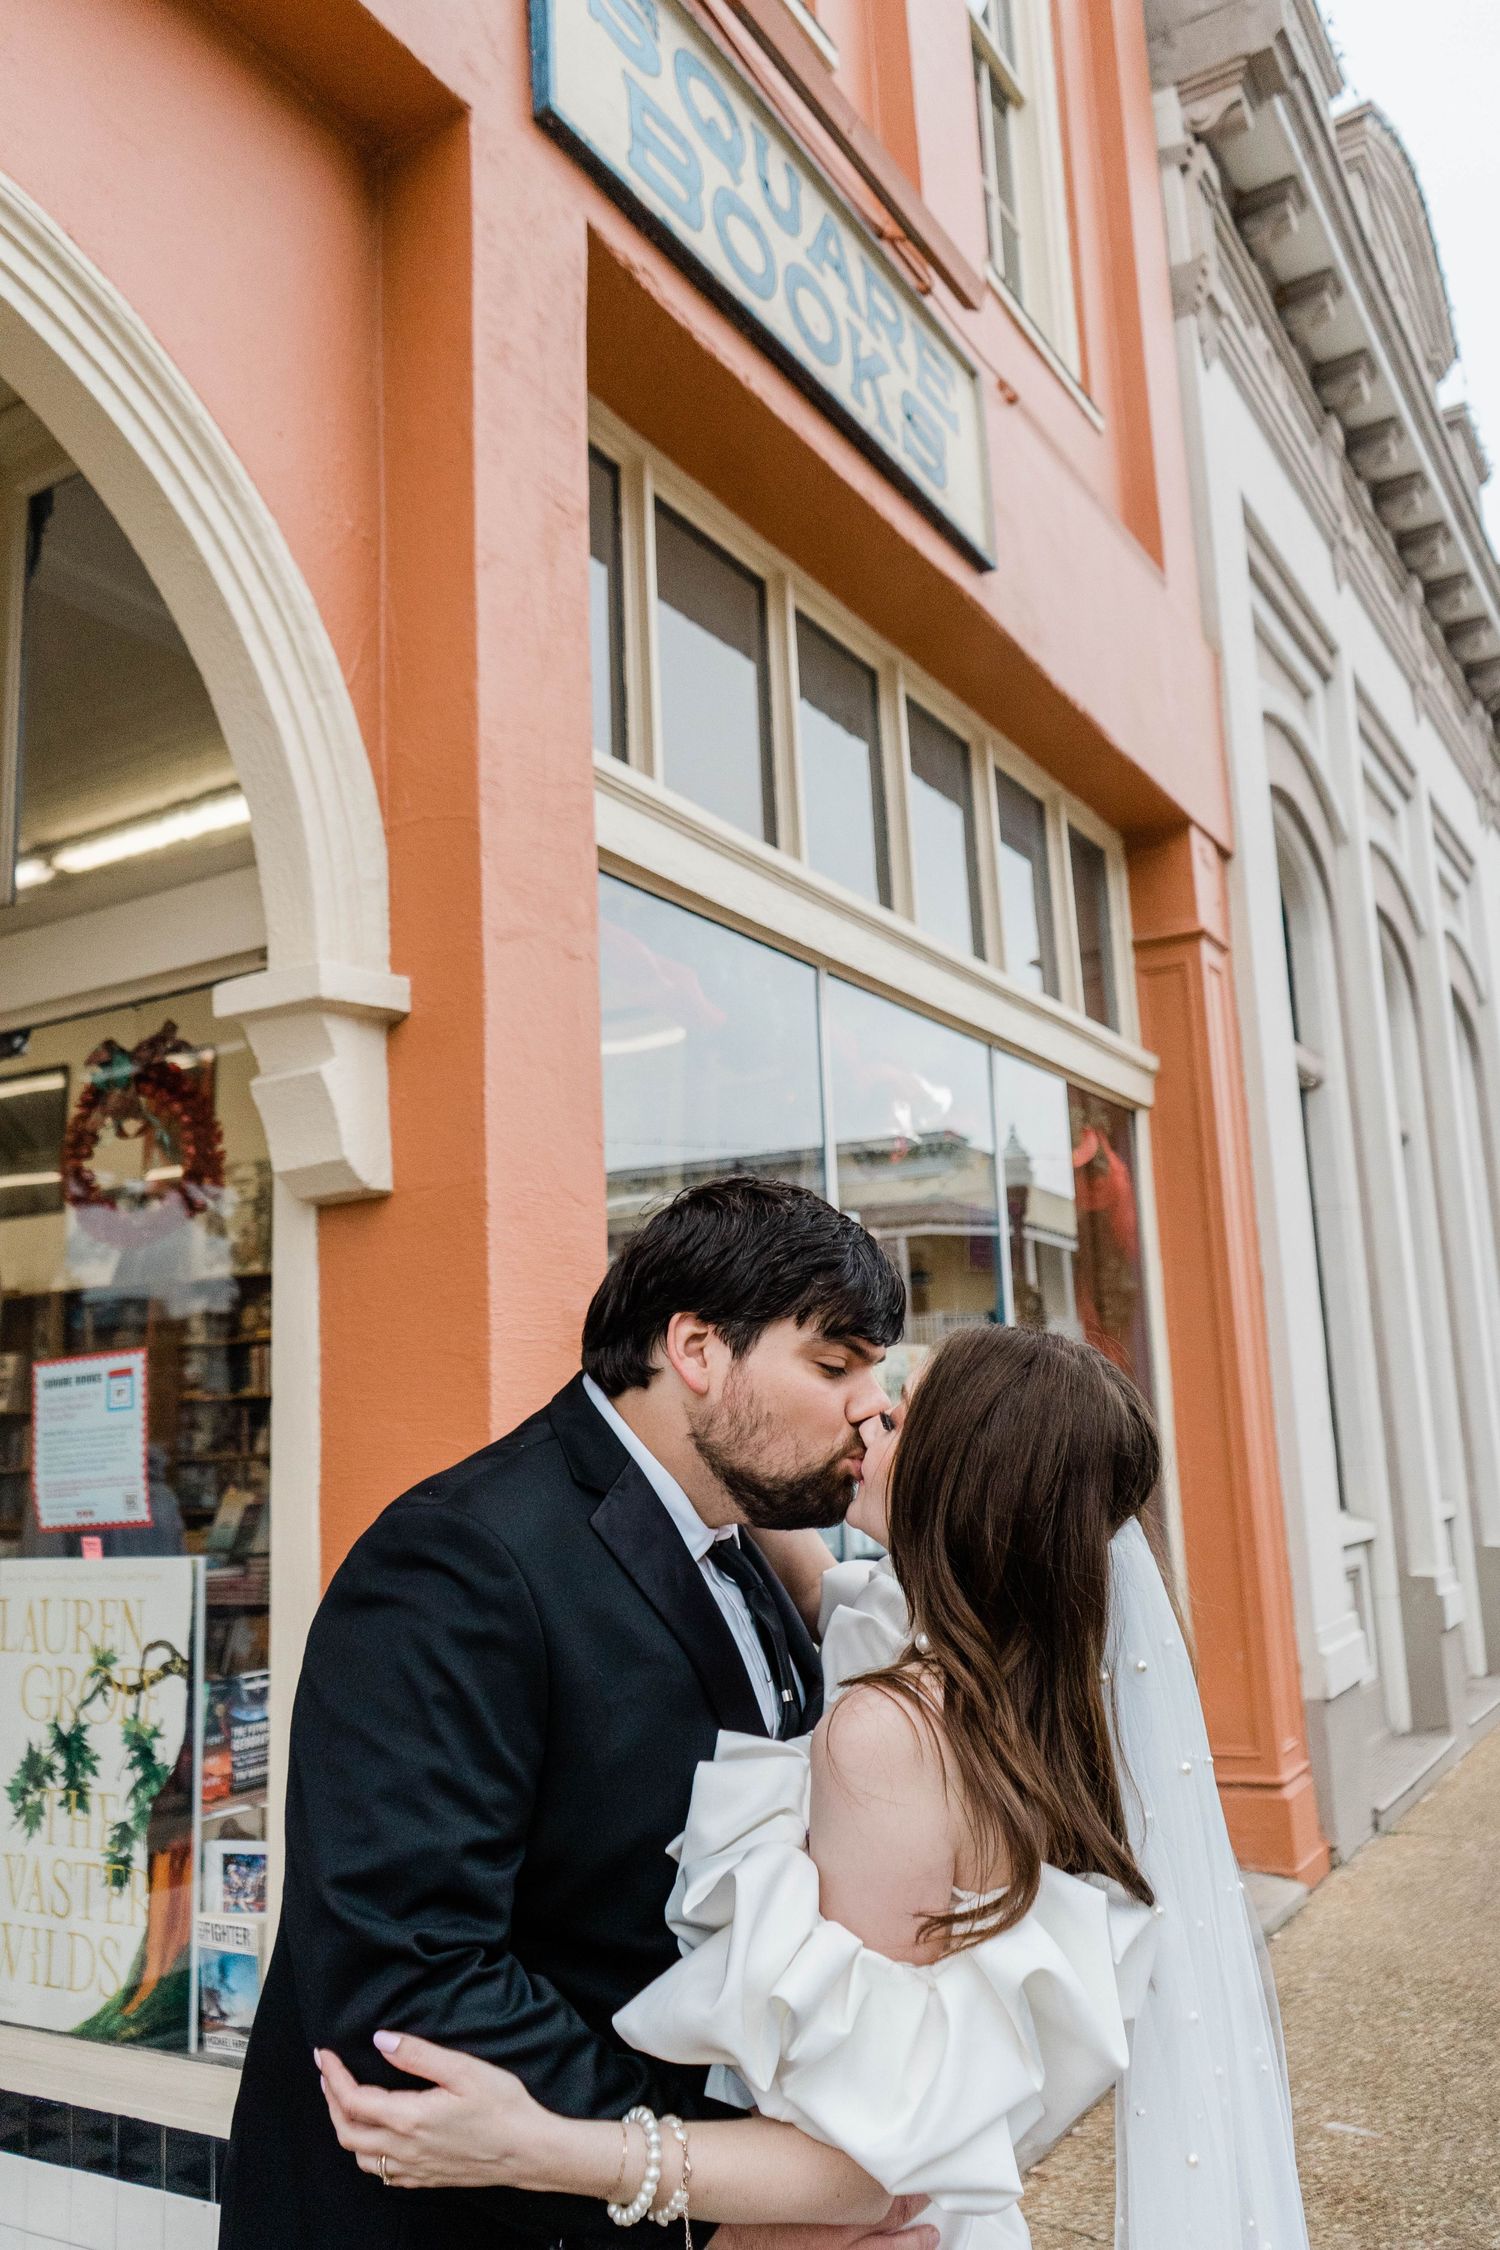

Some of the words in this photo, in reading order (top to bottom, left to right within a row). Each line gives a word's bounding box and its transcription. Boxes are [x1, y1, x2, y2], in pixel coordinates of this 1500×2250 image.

[589, 0, 960, 438] SQUARE
[623, 69, 948, 490] BOOKS
[0, 1597, 146, 1655] LAUREN
[39, 1788, 120, 1852] THE
[4, 1853, 151, 1927] VASTER
